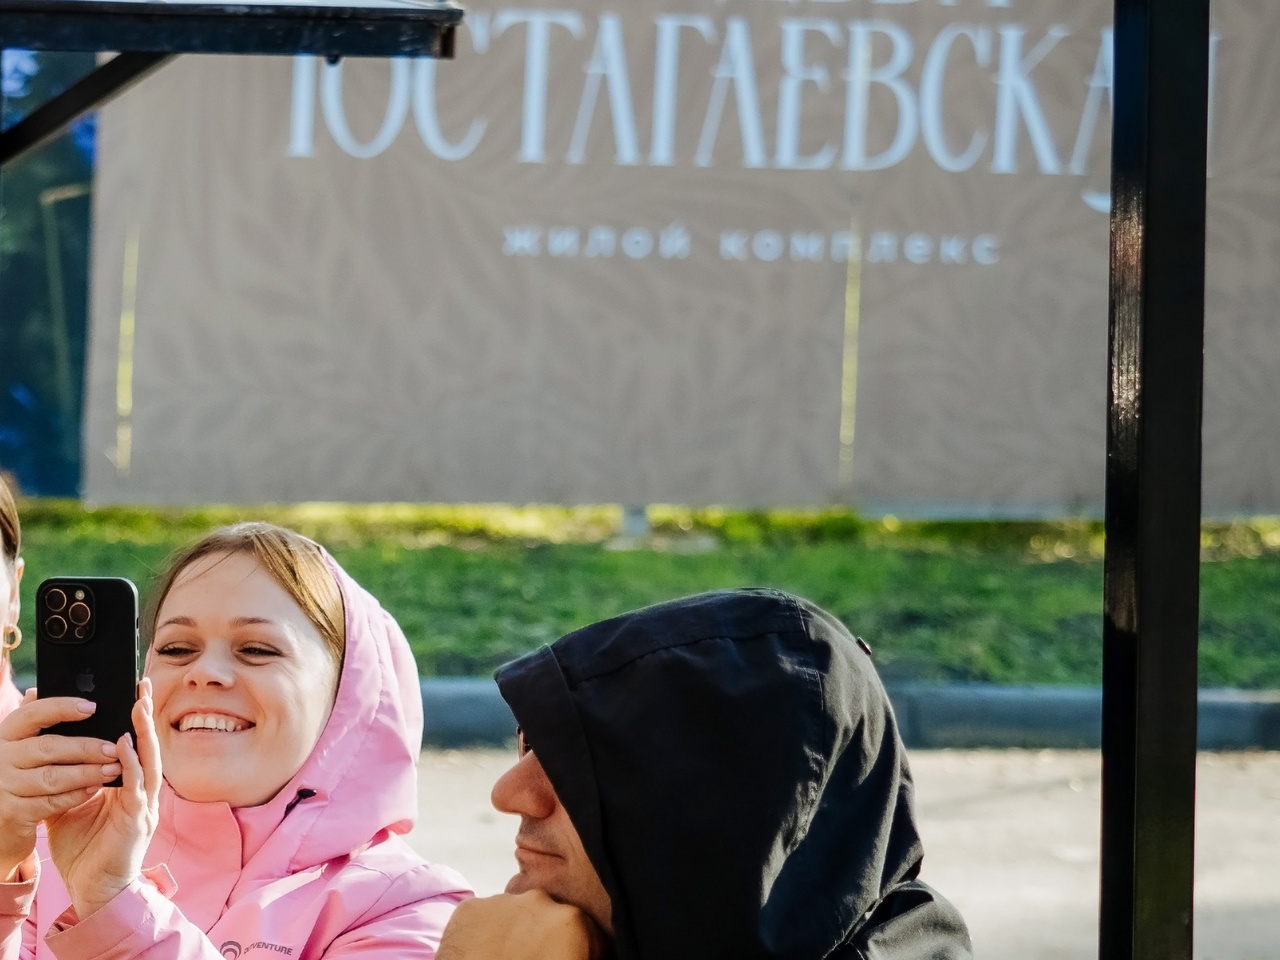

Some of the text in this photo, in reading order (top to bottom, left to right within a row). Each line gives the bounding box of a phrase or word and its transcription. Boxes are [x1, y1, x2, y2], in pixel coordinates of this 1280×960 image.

[287, 11, 1219, 213] ОСТАГАЕВСКА
[502, 220, 1001, 265] жилой комплекс
[243, 942, 293, 956] OVENTURE
